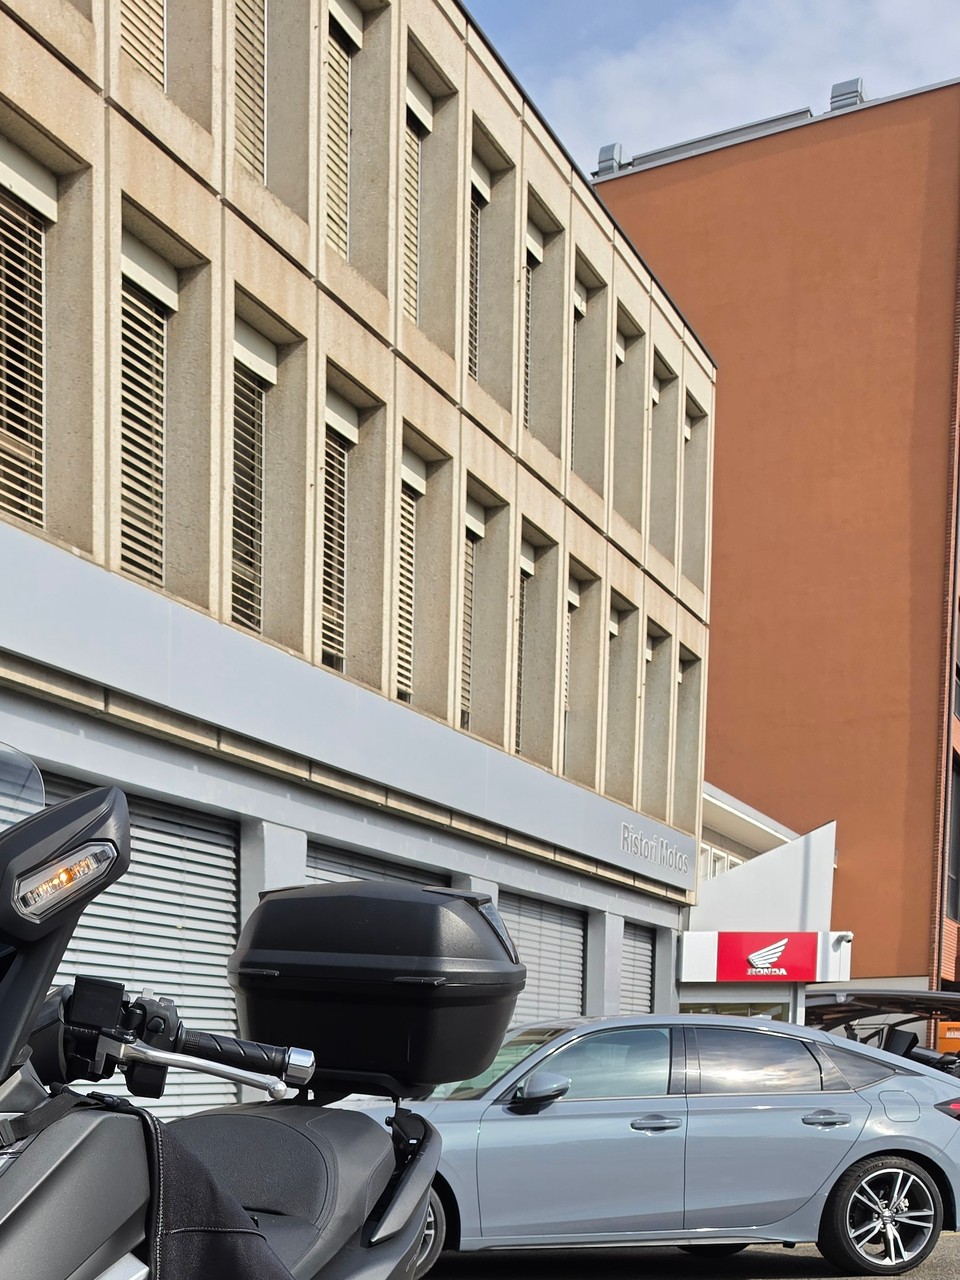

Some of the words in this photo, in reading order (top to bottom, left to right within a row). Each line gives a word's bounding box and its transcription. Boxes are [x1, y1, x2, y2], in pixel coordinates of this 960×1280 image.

[621, 821, 657, 865] Ristori
[658, 837, 689, 875] Motos
[746, 967, 788, 976] HONDA
